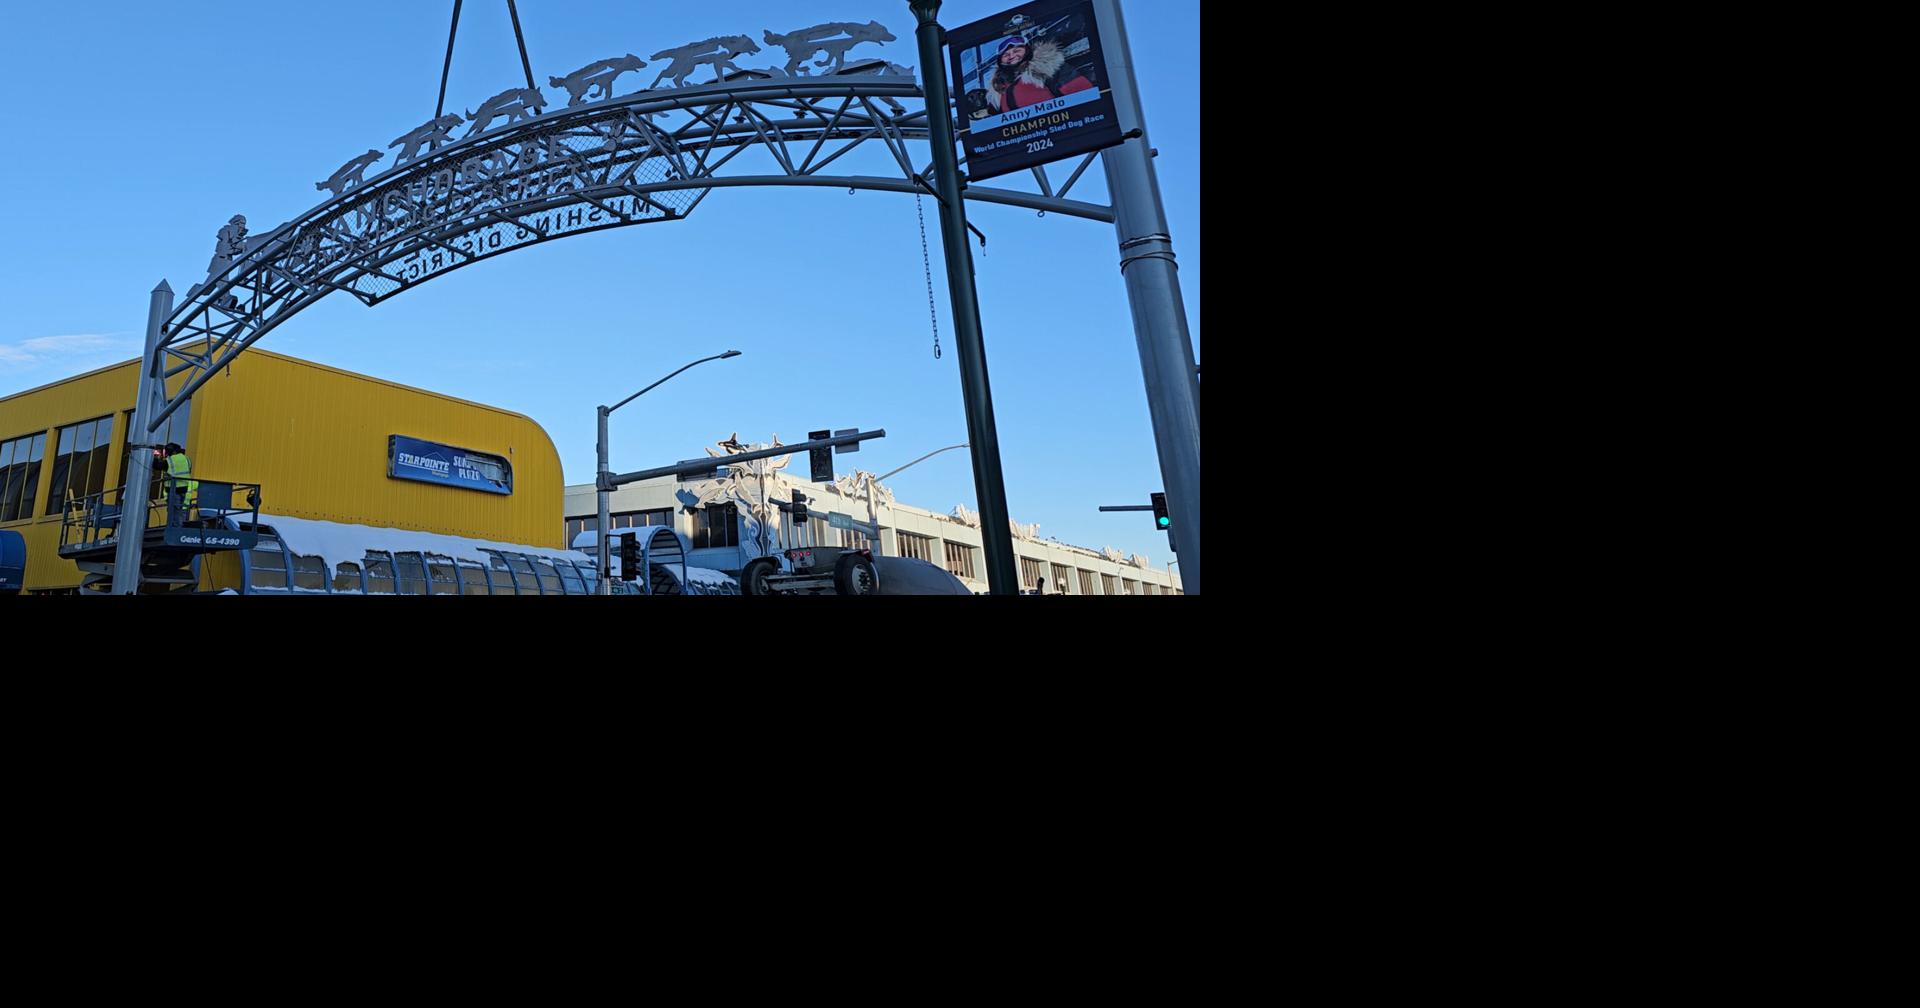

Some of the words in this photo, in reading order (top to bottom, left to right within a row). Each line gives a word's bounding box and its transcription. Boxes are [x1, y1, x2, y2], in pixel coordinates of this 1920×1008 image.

[1001, 109, 1031, 124] Anny
[1002, 111, 1071, 137] CHAMPION
[974, 142, 995, 154] World
[996, 129, 1048, 148] Championship
[1049, 123, 1066, 134] Sled
[1068, 118, 1084, 130] Dog
[1084, 113, 1105, 125] Race
[1026, 138, 1054, 154] 2024
[331, 132, 574, 241] ANCHORAGE
[323, 203, 438, 266] MUSHING
[450, 161, 582, 214] DISTRICT
[398, 452, 450, 471] STARPOINTE
[180, 535, 201, 544] Genie
[205, 536, 240, 546] GS-4390
